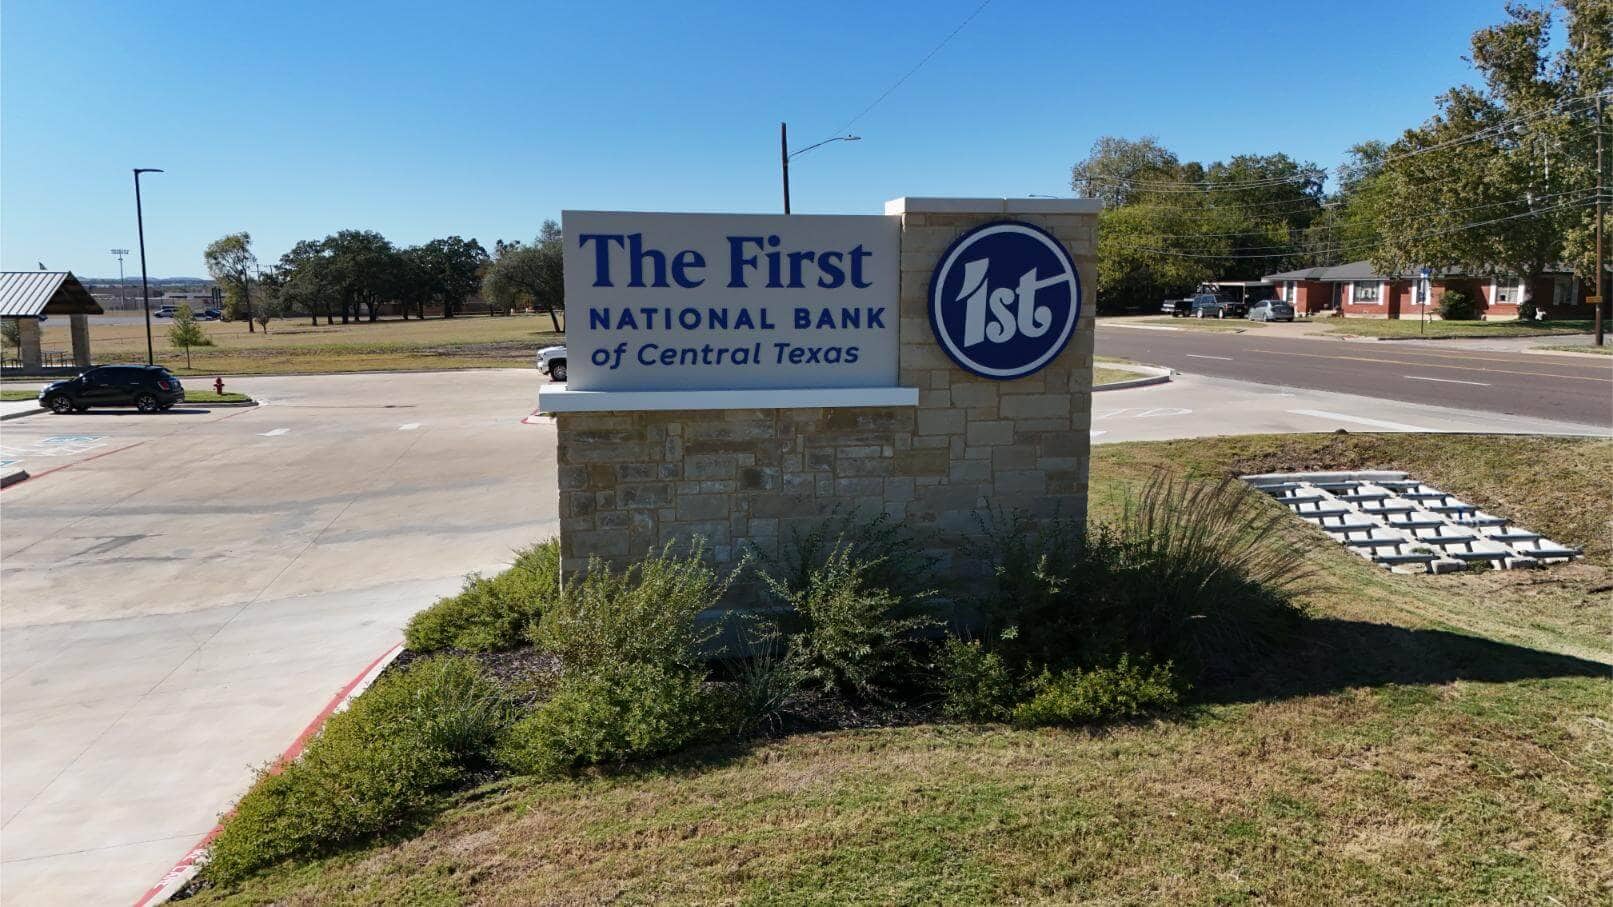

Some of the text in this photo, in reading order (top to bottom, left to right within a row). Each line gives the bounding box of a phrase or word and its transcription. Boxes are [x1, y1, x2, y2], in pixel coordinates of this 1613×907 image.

[579, 233, 873, 289] The First
[590, 308, 887, 330] NATIONAL BANK
[955, 257, 1066, 347] 1st
[591, 343, 860, 369] of Central Texas
